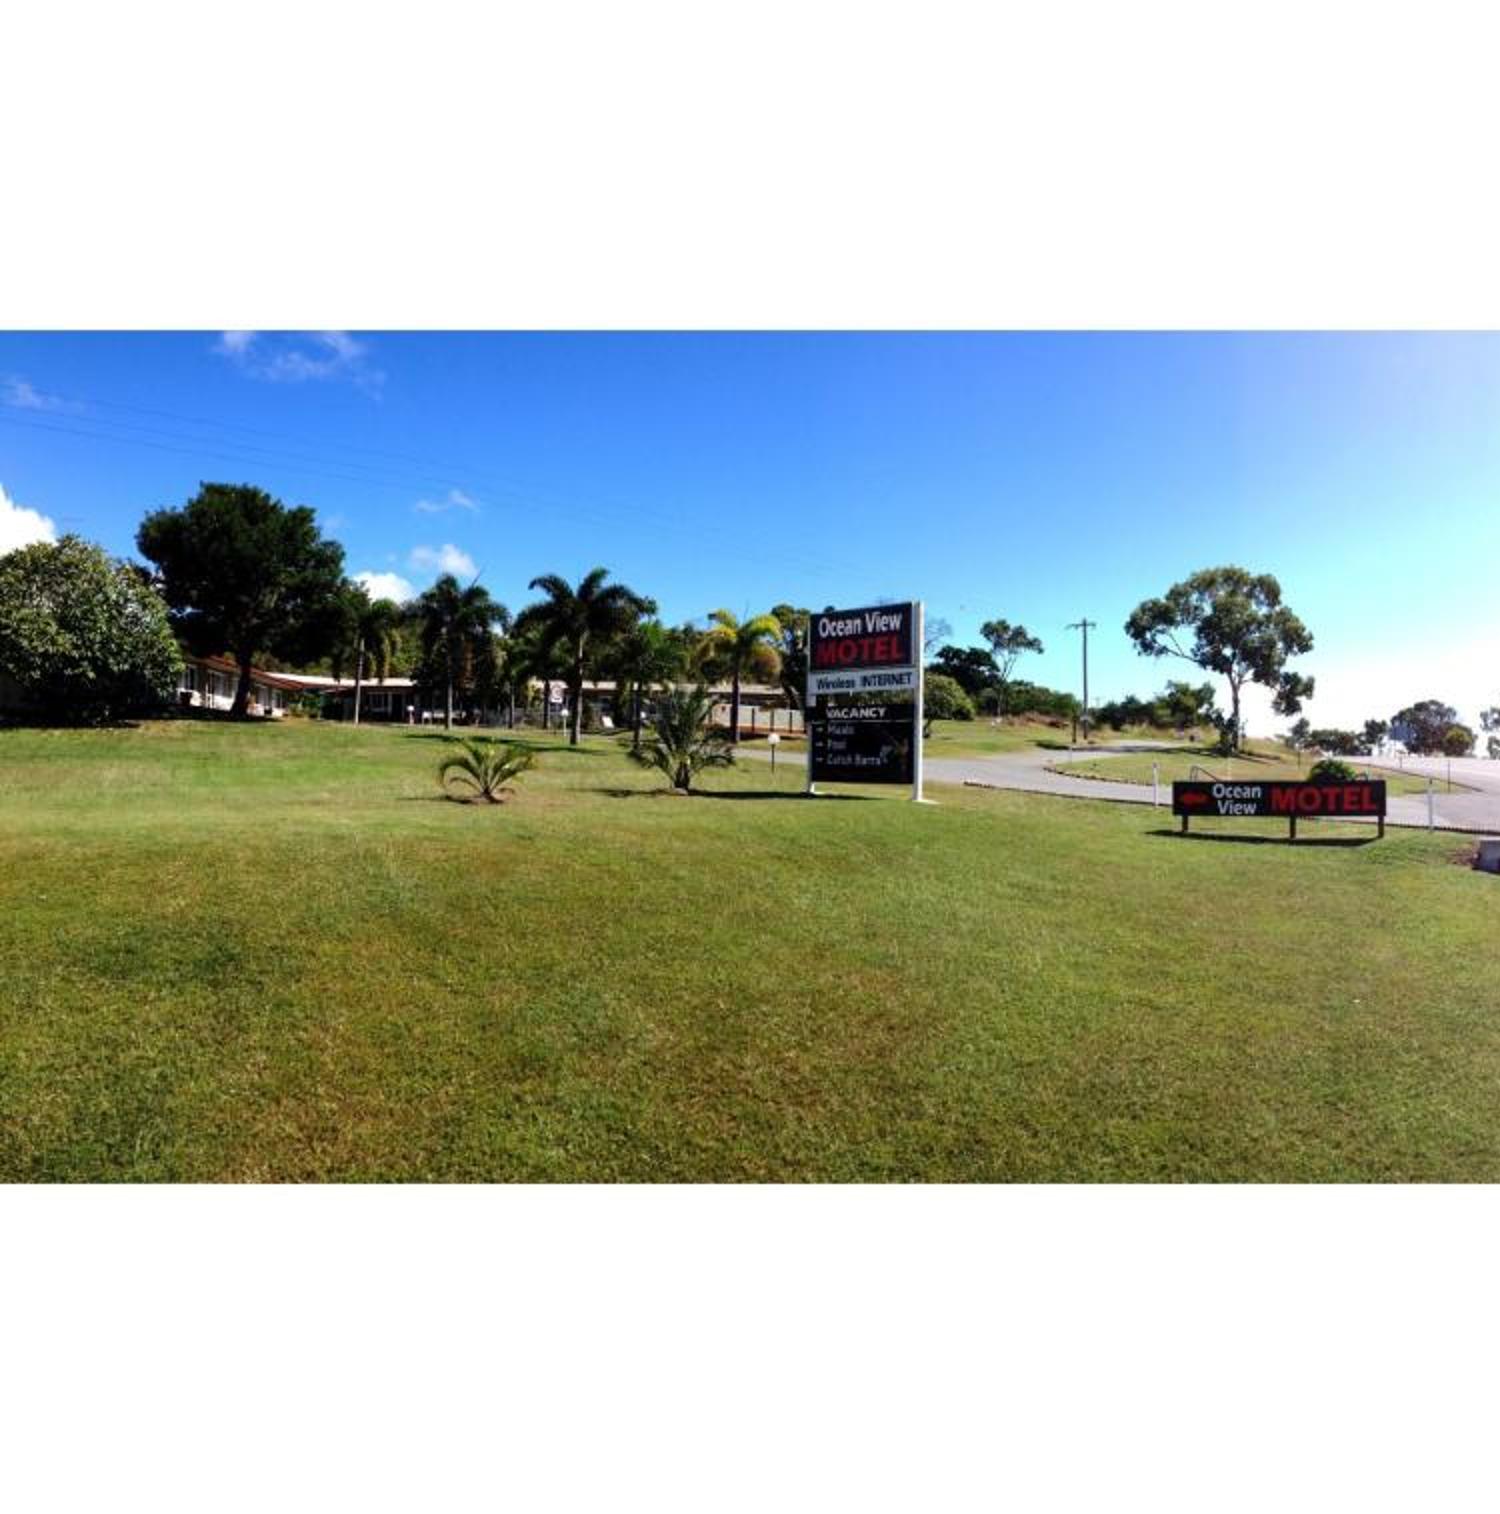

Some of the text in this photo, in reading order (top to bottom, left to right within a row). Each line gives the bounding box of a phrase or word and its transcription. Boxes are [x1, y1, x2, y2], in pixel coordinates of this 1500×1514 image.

[818, 611, 902, 638] Ocean View
[816, 636, 900, 666] MOTEL
[816, 672, 913, 690] Wireless INTERNET
[826, 706, 887, 719] VACANCY
[1212, 783, 1262, 799] Ocean
[1270, 786, 1377, 812] MOTEL
[1216, 799, 1257, 815] View
